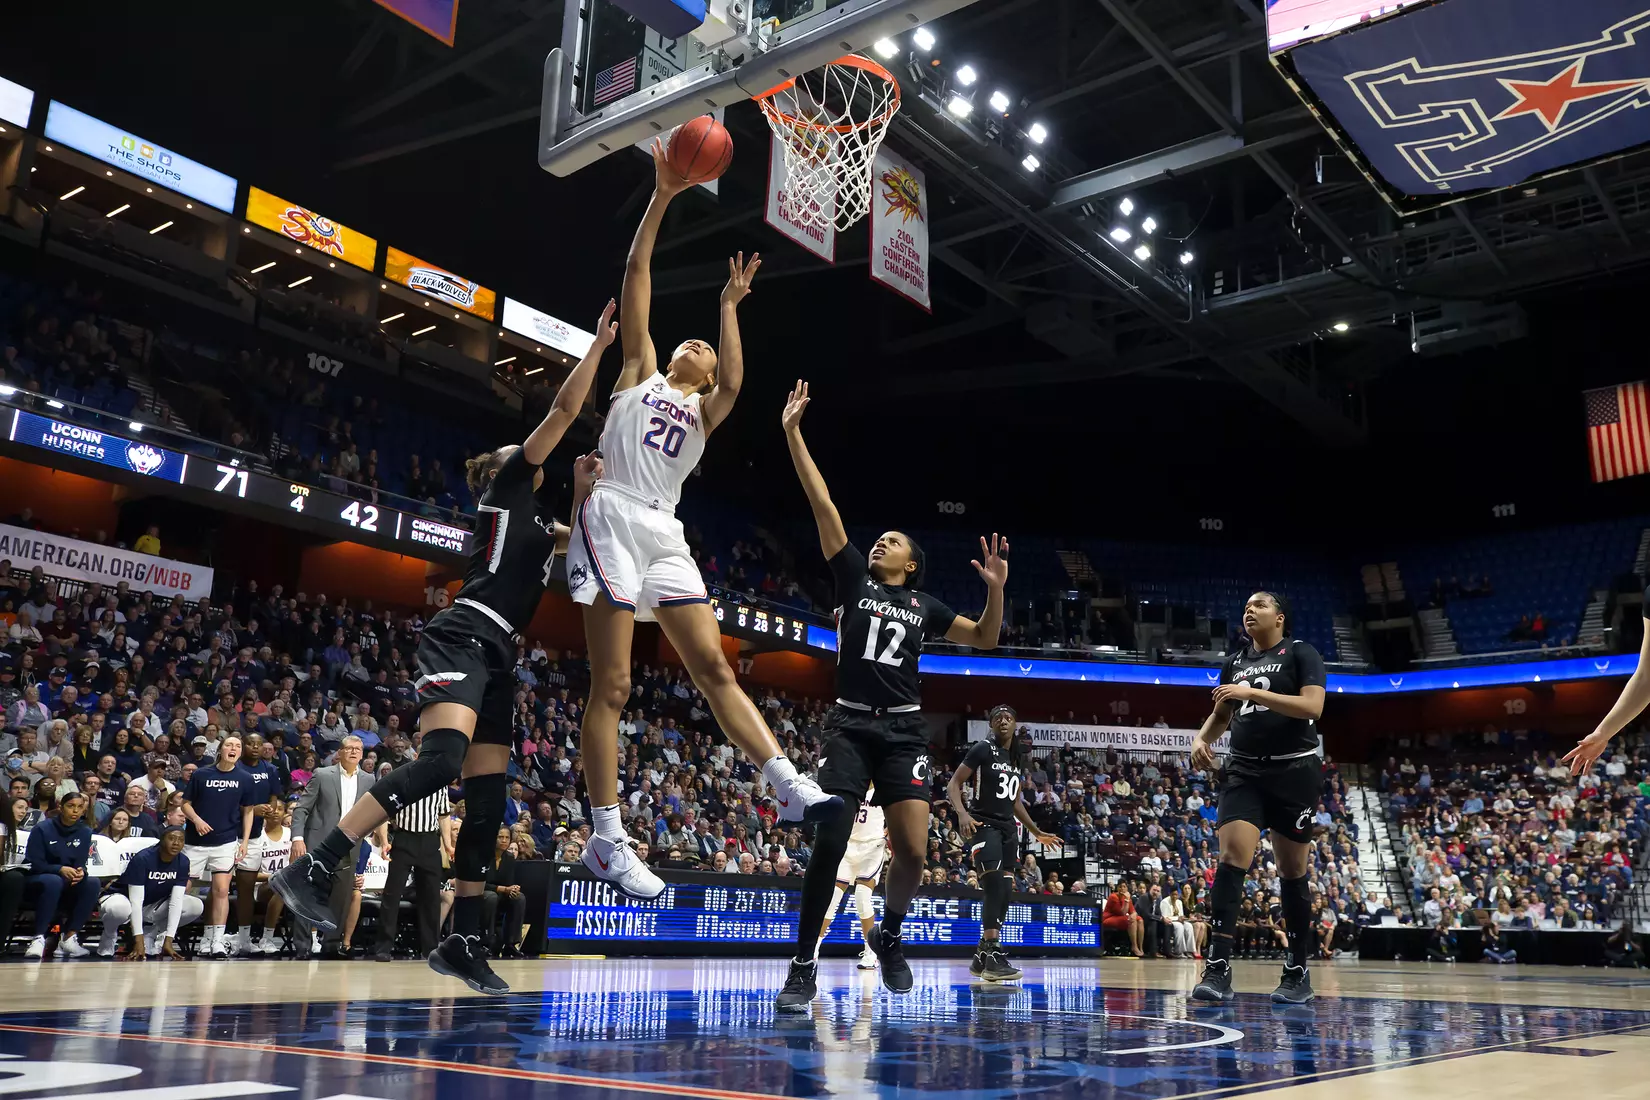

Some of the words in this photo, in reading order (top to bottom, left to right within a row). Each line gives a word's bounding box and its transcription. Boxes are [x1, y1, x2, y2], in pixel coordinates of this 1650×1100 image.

[108, 144, 134, 161] THE
[137, 157, 181, 181] SHOPS
[897, 229, 914, 247] 2004
[889, 237, 920, 264] EASTERN
[882, 246, 925, 281] CONFERENCE
[884, 260, 924, 292] CHAMPIONS
[437, 280, 467, 301] WOLVES
[307, 352, 344, 378] 107
[641, 392, 699, 432] UCONN
[51, 422, 102, 444] UCONN
[642, 416, 687, 459] 20
[42, 433, 105, 459] HUSKIES
[213, 464, 249, 498] 71
[290, 484, 310, 497] QTR
[290, 495, 304, 513] 4
[936, 500, 965, 515] 109
[340, 501, 379, 532] 42
[411, 530, 463, 552] BEARCATS
[412, 519, 465, 541] CINCINNATI
[423, 586, 450, 608] 16
[737, 606, 749, 615] AST
[792, 620, 804, 629] BLK
[857, 597, 923, 627] CINCINNATI
[738, 614, 746, 627] 8
[753, 618, 768, 633] 28
[775, 624, 784, 637] 4
[793, 628, 801, 641] 2
[860, 615, 907, 667] 12
[737, 658, 754, 675] 17
[1232, 663, 1282, 682] CINCINNATI
[1033, 728, 1087, 743] AMERICAN
[1090, 730, 1138, 745] WOMEN'S
[205, 779, 239, 788] UCONN
[995, 772, 1020, 801] 30
[261, 849, 290, 859] UCONN
[148, 871, 177, 880] UCONN
[268, 859, 284, 874] 44
[575, 910, 658, 937] ASSISTANCE
